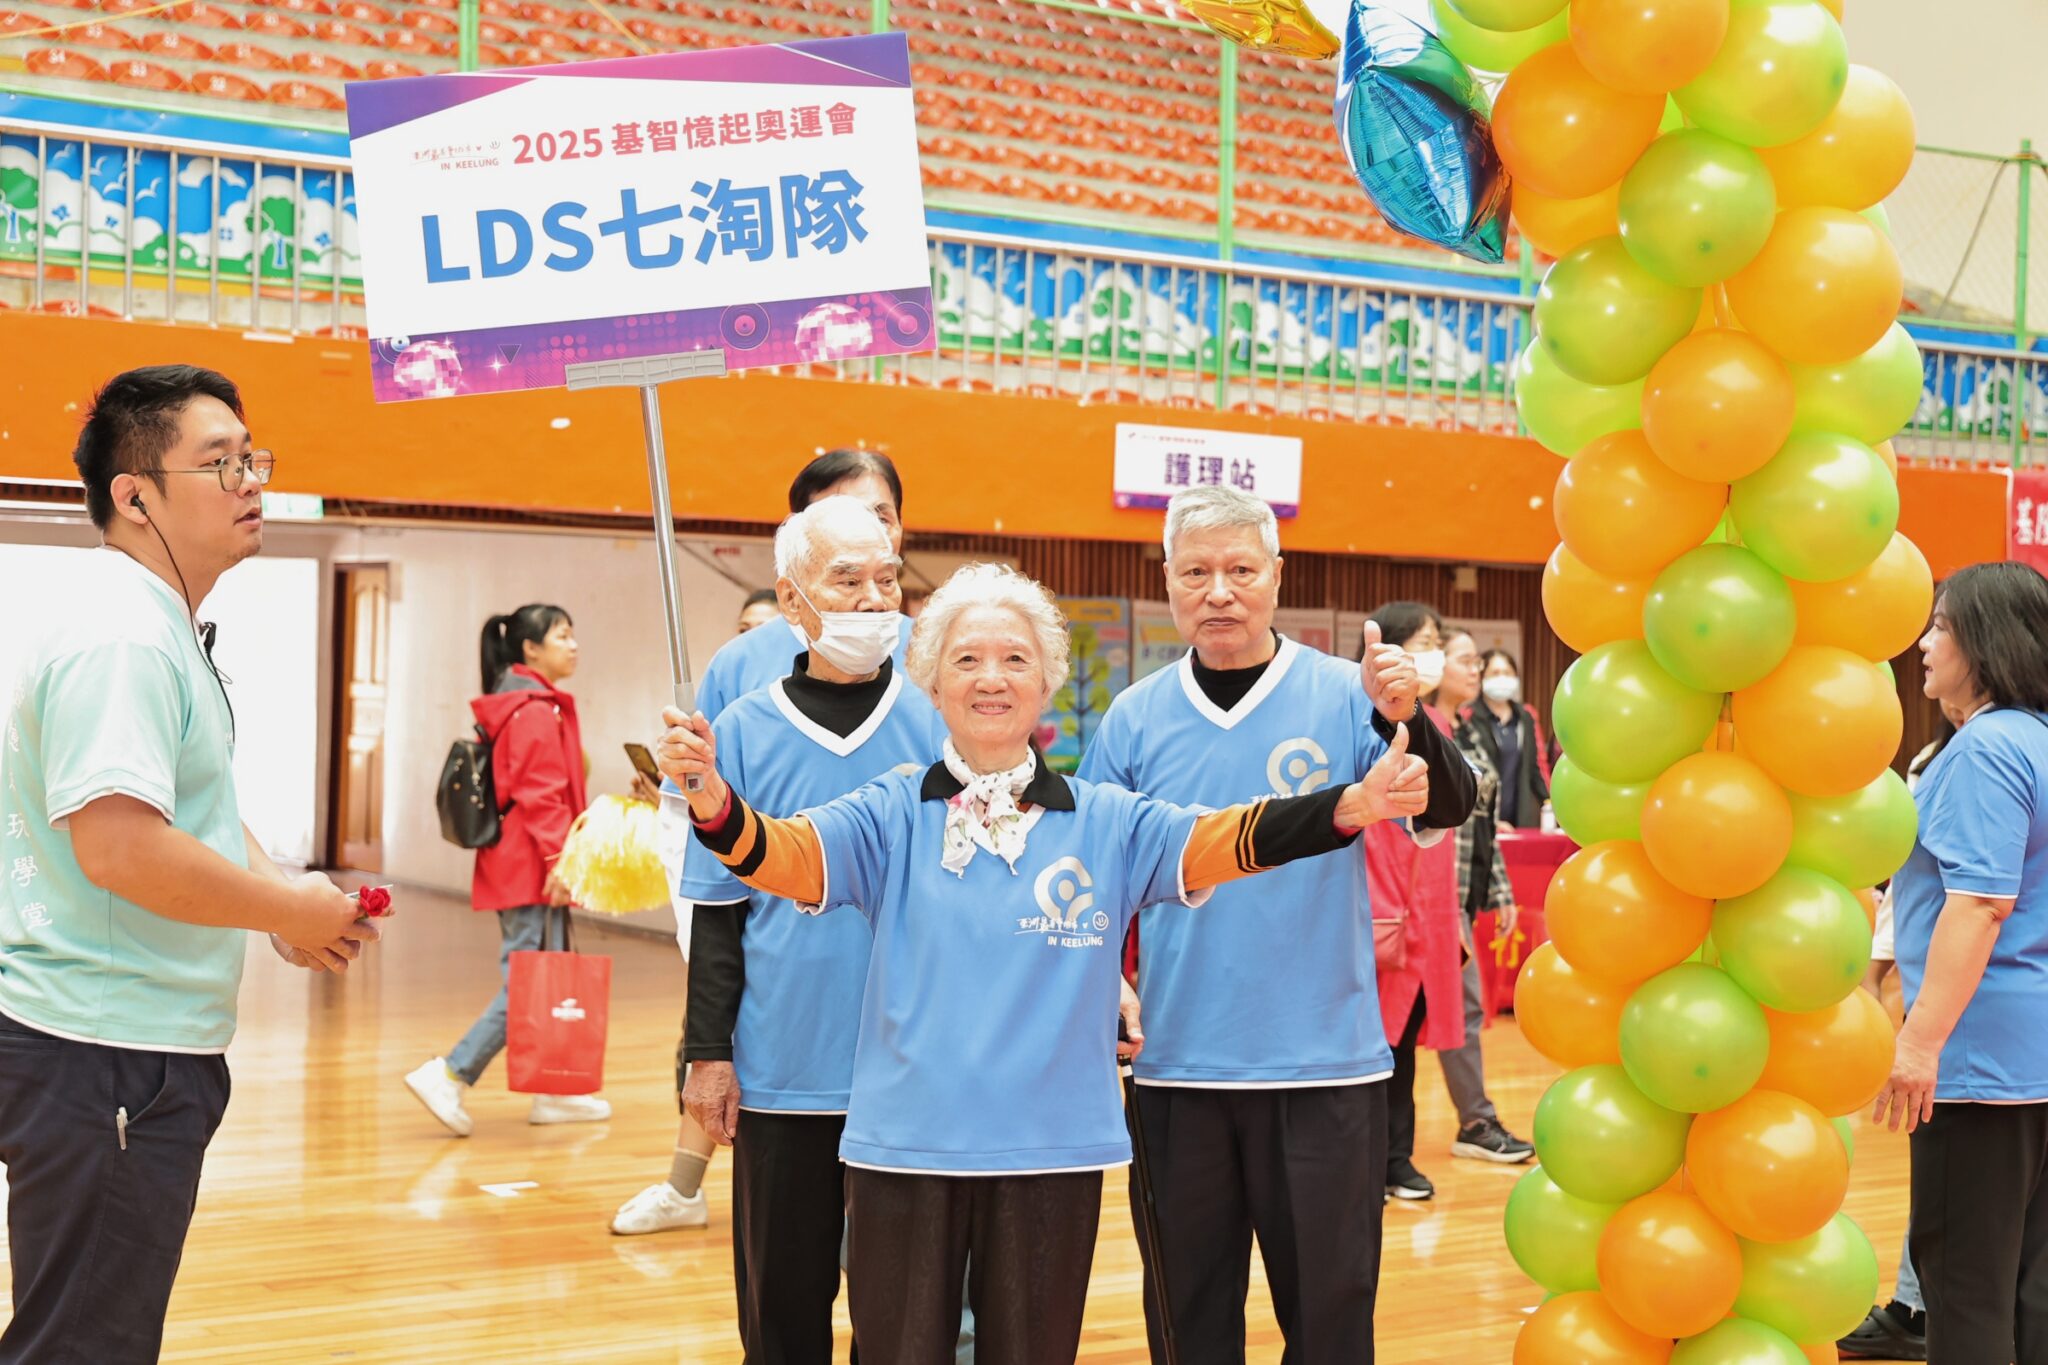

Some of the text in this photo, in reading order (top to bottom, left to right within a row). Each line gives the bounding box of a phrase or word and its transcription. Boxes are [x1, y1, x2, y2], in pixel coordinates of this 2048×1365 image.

[512, 102, 858, 164] 2025 基智憶起奧運會
[441, 158, 499, 170] IN KEELUNG
[421, 168, 869, 284] LDS七淘隊
[1164, 452, 1256, 491] 護理站
[1047, 935, 1104, 948] IN KEELUNG
